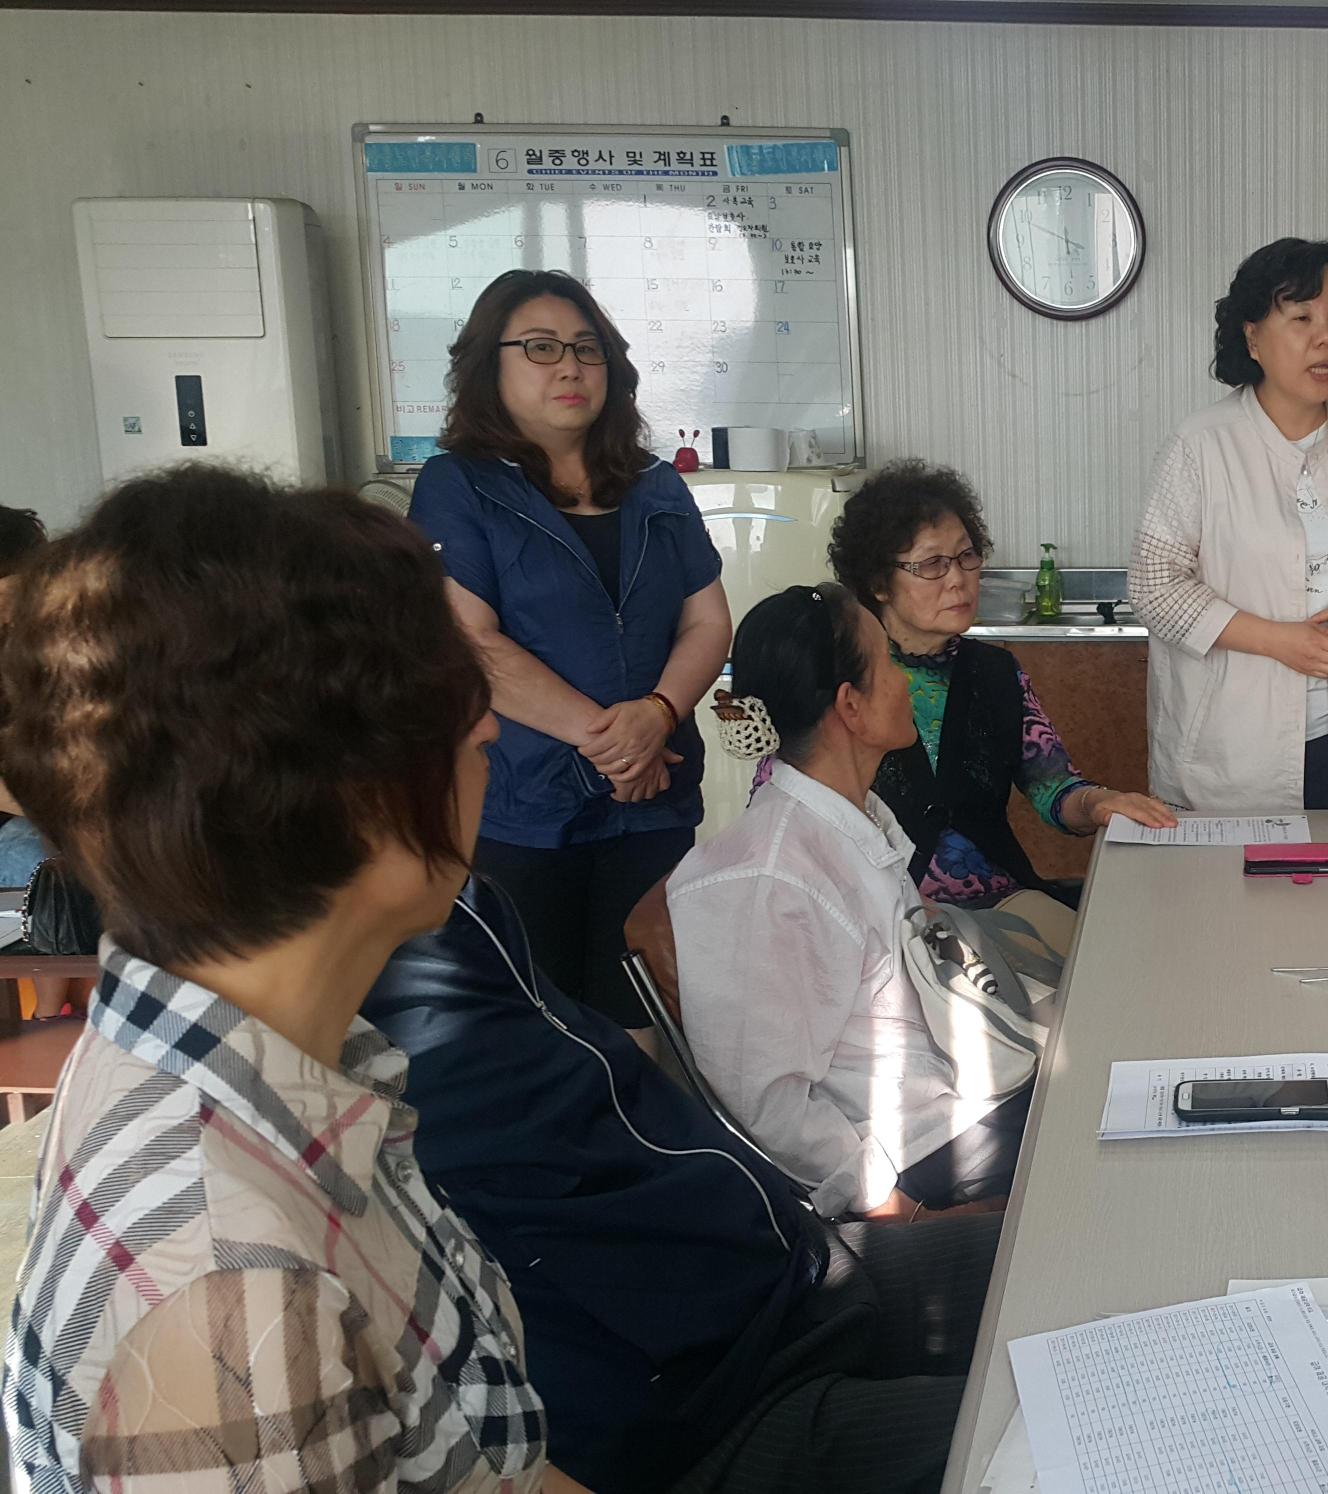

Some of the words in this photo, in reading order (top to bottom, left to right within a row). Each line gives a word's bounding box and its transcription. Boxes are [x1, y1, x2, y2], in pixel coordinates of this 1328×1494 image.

[495, 151, 510, 170] 6
[525, 148, 615, 166] 월중행사
[626, 151, 643, 166] 및
[653, 150, 718, 167] 계획표
[408, 183, 426, 191] SUN
[471, 182, 494, 191] MON
[540, 183, 555, 191] TUE
[602, 183, 623, 192] WED
[669, 184, 686, 193] THU
[735, 185, 749, 193] FRI
[1059, 186, 1072, 200] 12
[706, 195, 716, 207] 2
[769, 197, 777, 209] 3
[1102, 210, 1112, 223] 2
[449, 236, 458, 248] 5
[514, 236, 525, 248] 6
[644, 237, 653, 249] 8
[771, 239, 782, 252] 10
[451, 278, 462, 289] 12
[647, 279, 659, 290] 15
[711, 280, 723, 292] 16
[774, 280, 785, 293] 17
[1064, 281, 1073, 296] 6
[1086, 276, 1096, 289] 5
[649, 321, 662, 332] 22
[713, 321, 727, 333] 23
[776, 321, 789, 334] 24
[391, 361, 405, 372] 25
[650, 361, 665, 373] 29
[715, 362, 728, 373] 30
[396, 405, 415, 414] 비고
